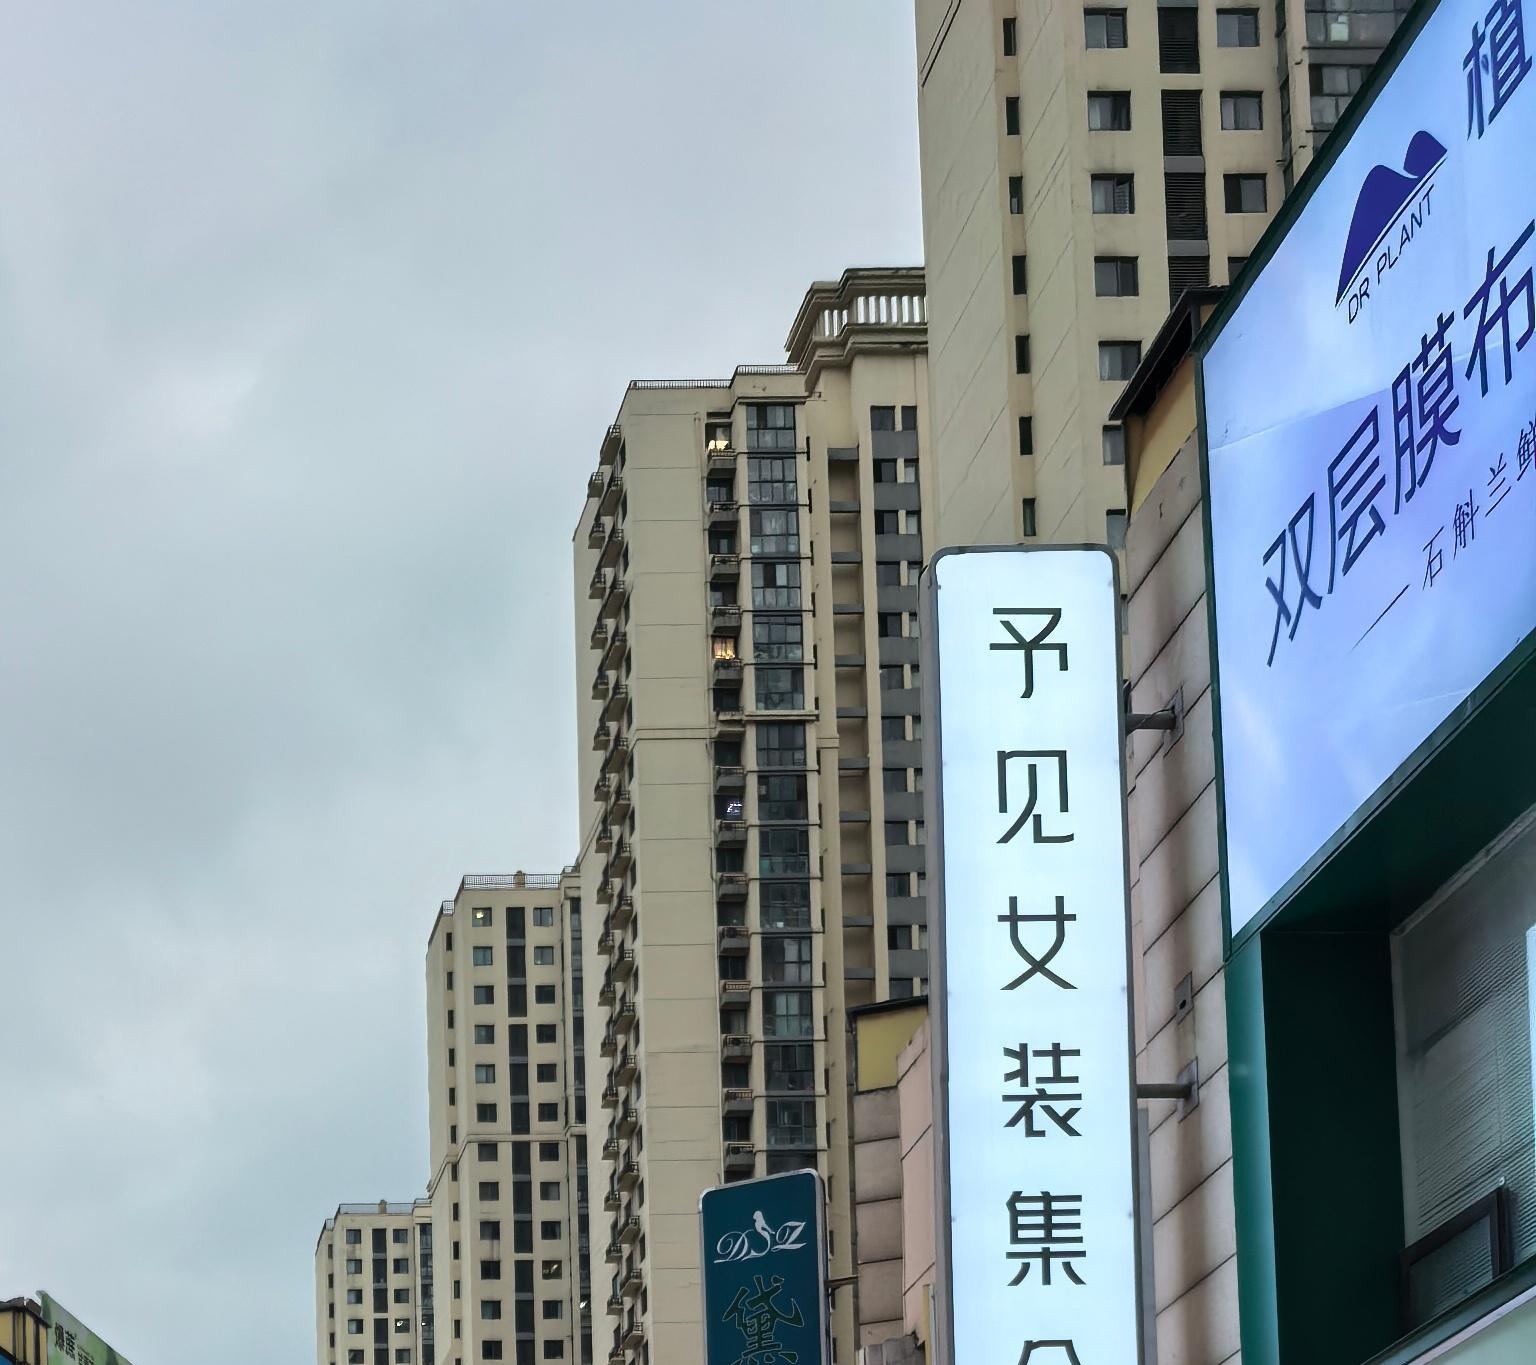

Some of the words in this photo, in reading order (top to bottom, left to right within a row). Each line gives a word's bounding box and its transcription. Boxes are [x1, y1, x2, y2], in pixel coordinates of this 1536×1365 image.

[1348, 276, 1372, 325] DR
[1376, 184, 1436, 288] PLANT
[1262, 218, 1536, 669] 双层膜布
